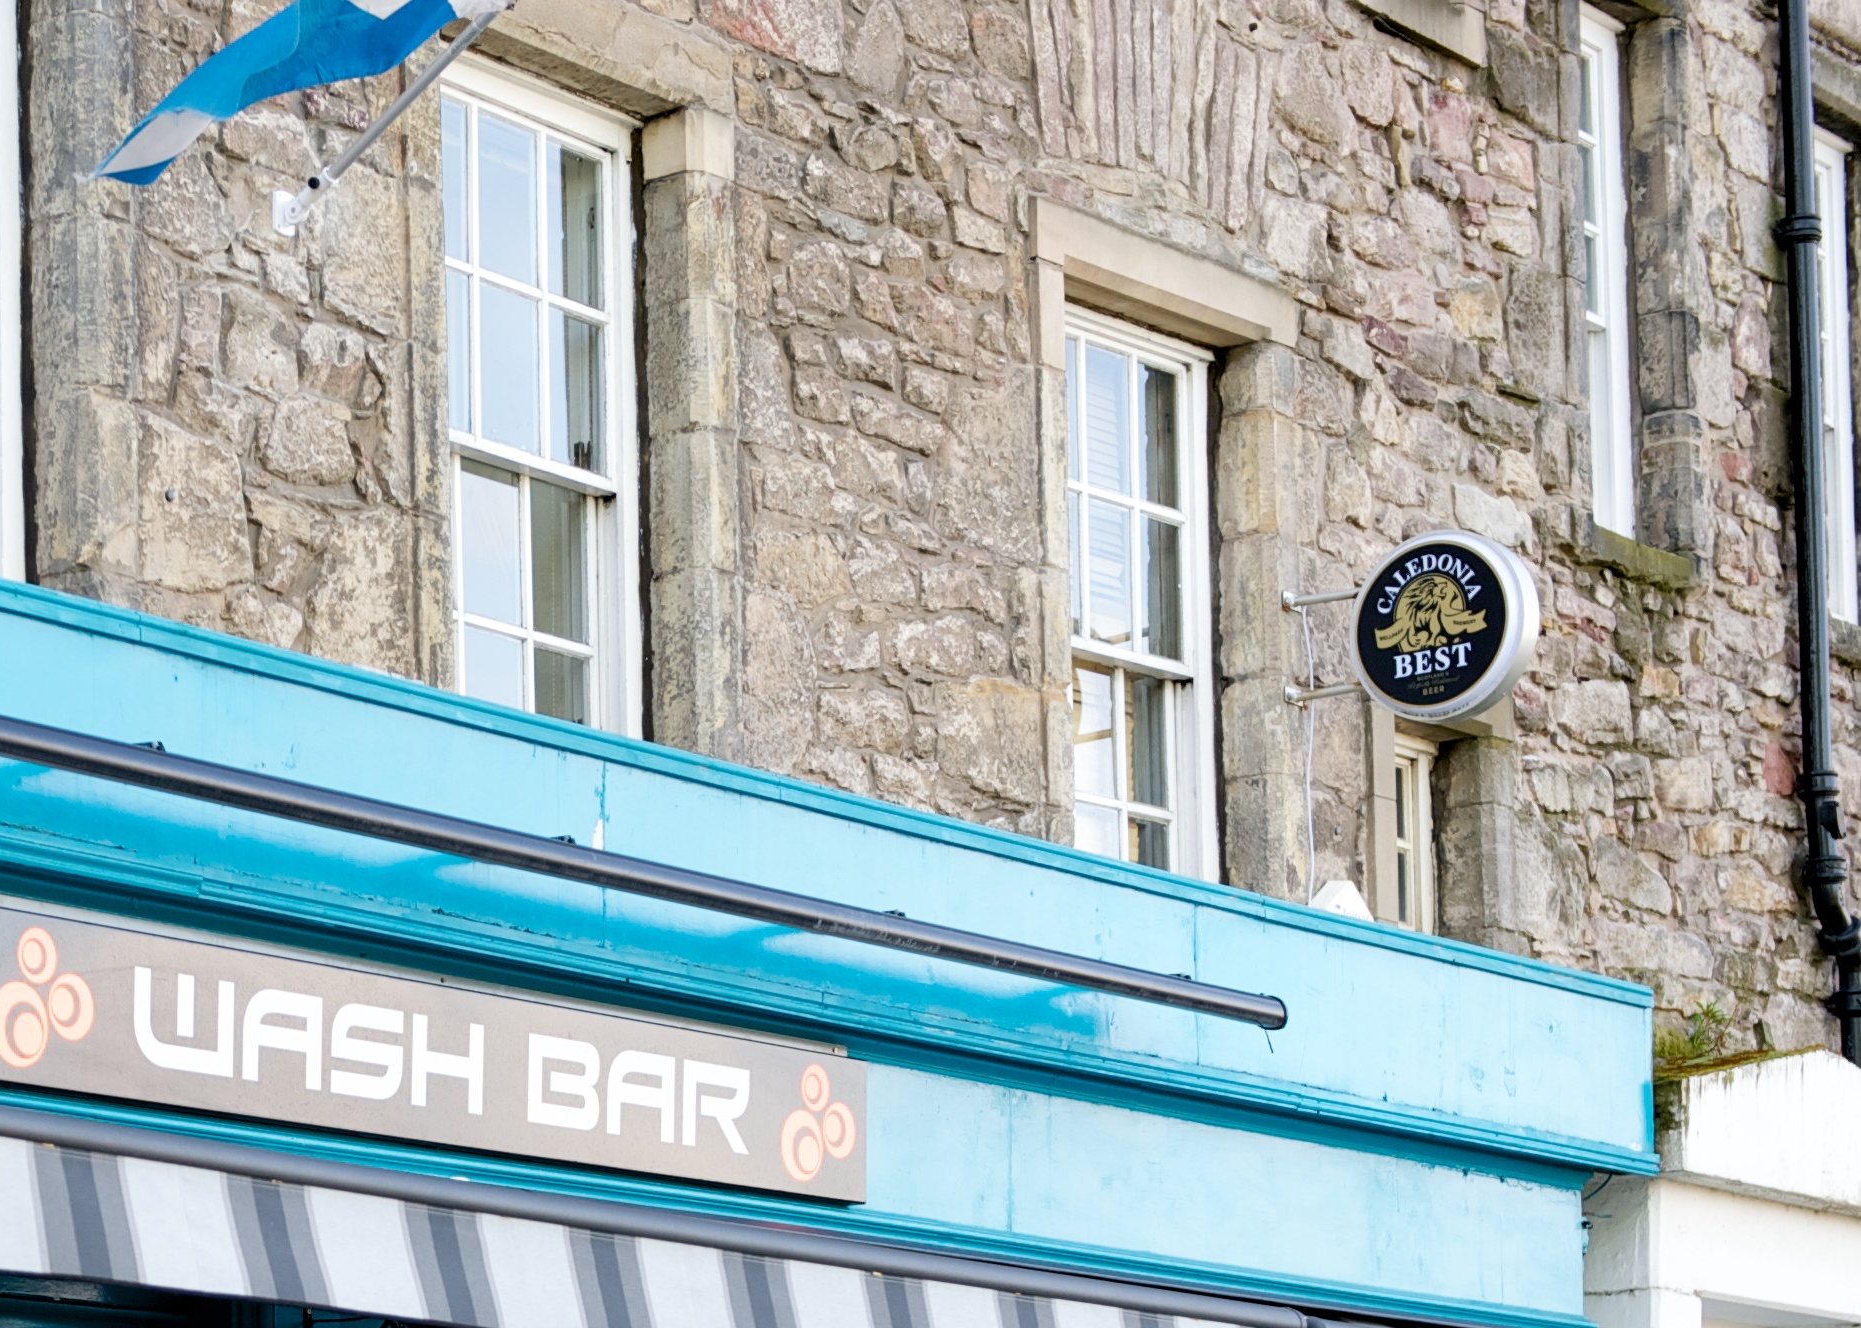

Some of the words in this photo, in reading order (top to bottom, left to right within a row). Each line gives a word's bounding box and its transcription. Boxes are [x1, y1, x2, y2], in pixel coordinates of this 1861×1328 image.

[1377, 553, 1482, 615] CALEDONIA
[1393, 642, 1472, 680] BEST
[134, 965, 484, 1116] WASH
[527, 1032, 751, 1155] BAR
